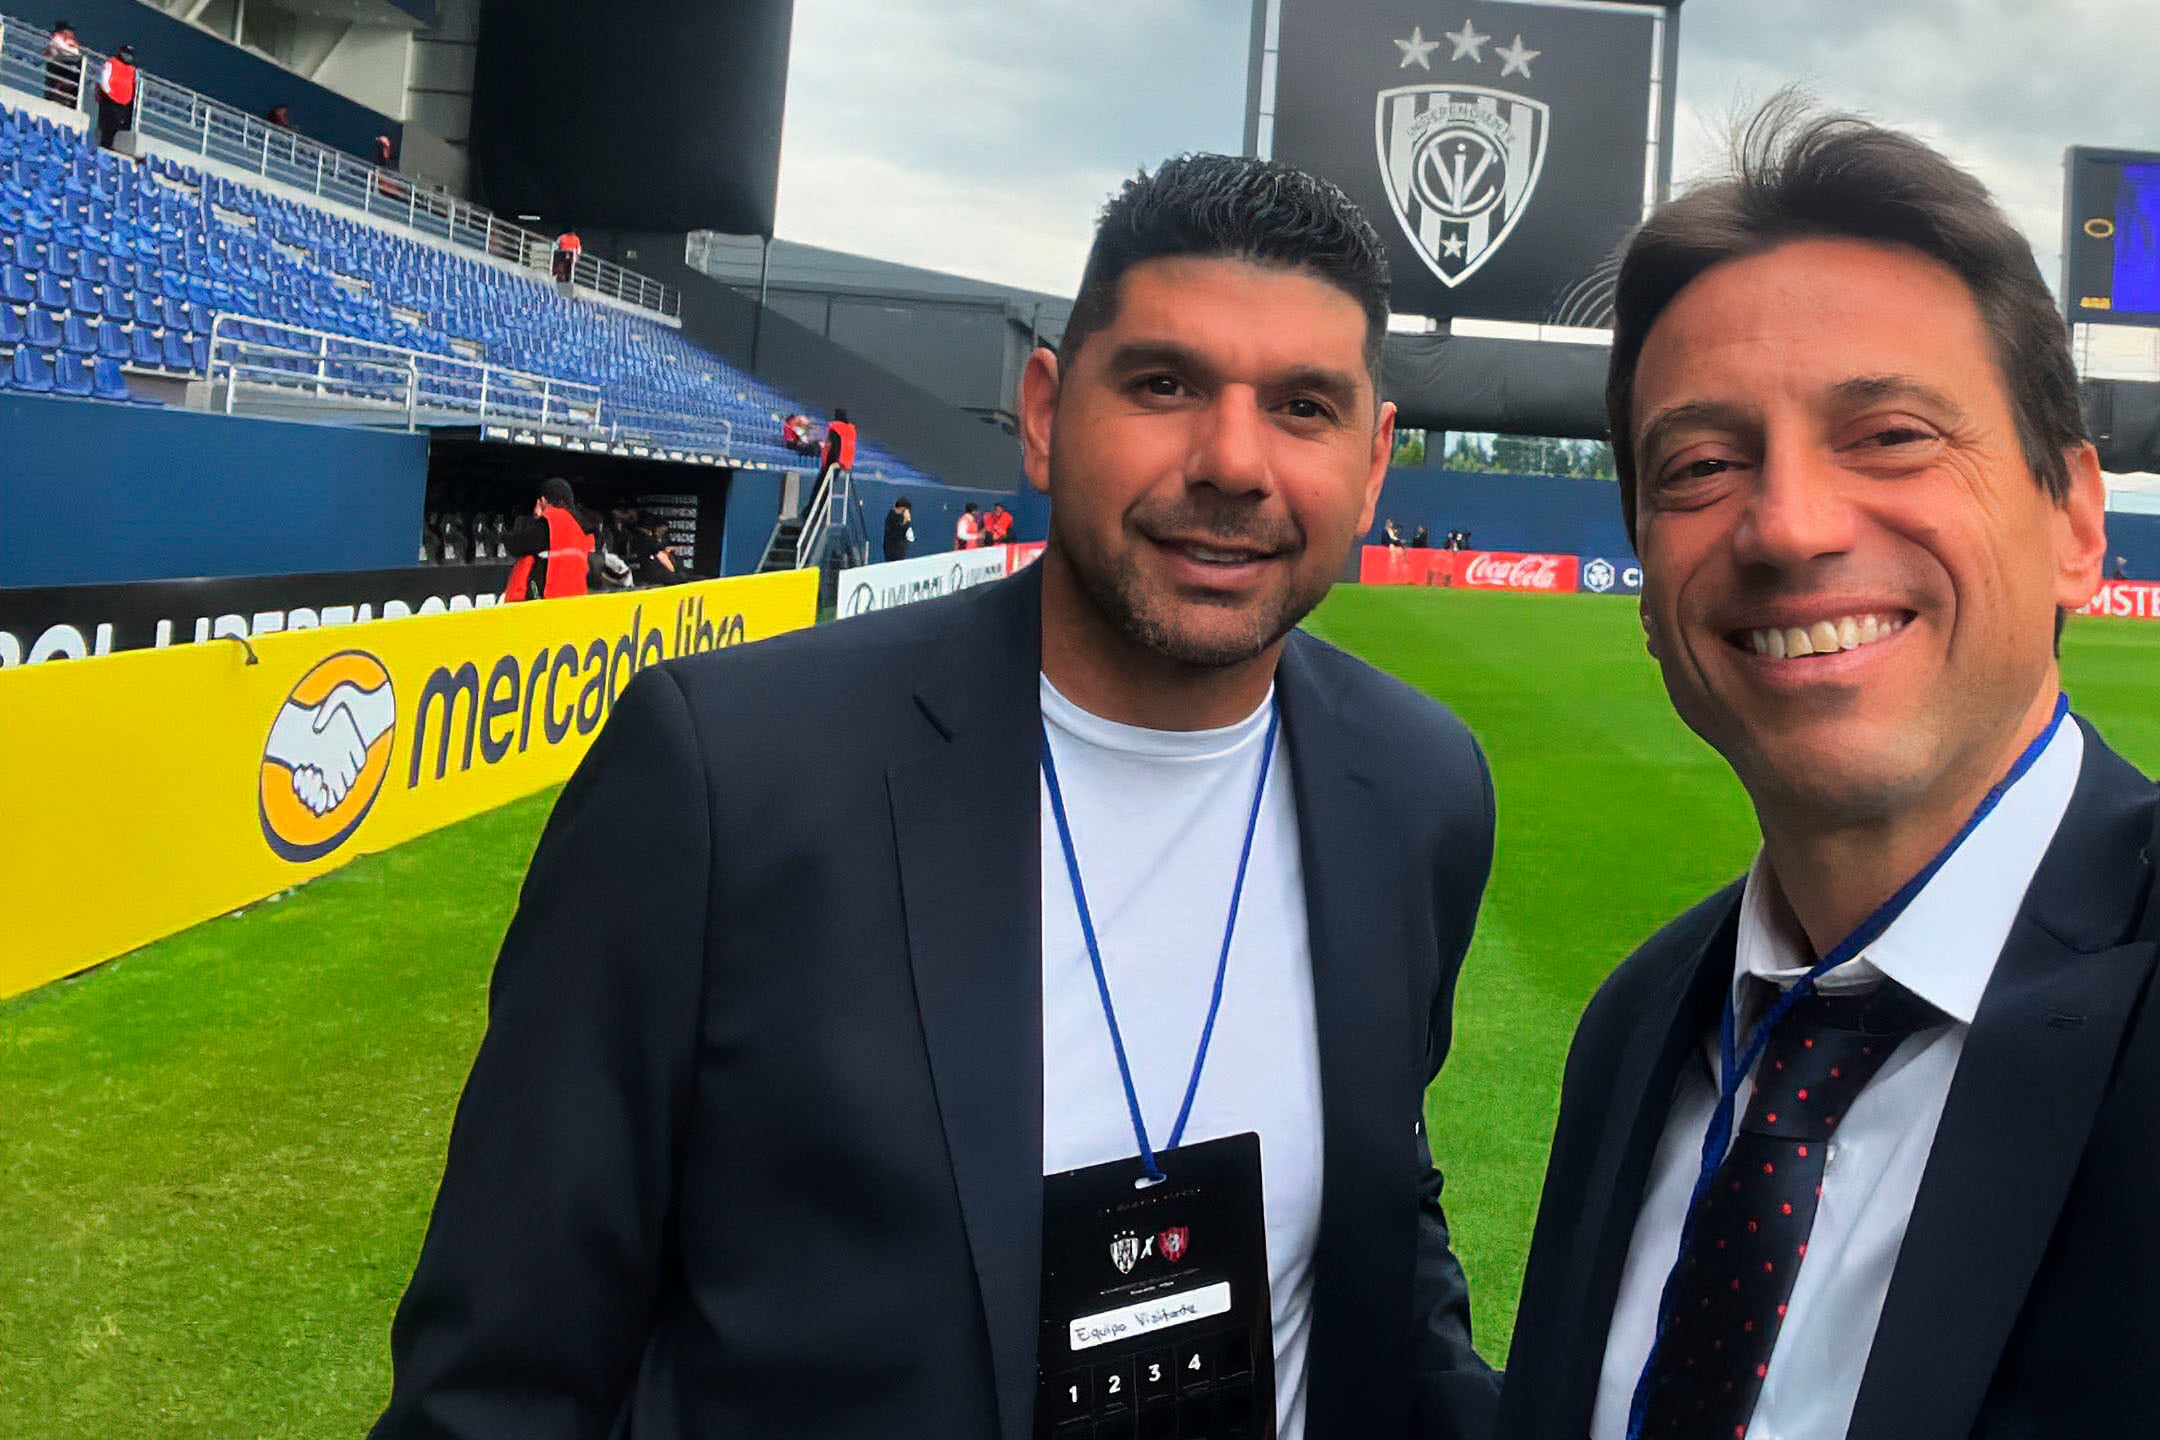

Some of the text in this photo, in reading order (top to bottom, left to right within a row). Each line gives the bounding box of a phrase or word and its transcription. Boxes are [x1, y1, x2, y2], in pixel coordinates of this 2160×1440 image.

[2075, 584, 2160, 617] MSTE
[1075, 1322, 1127, 1342] Equipo
[1068, 1353, 1201, 1403] 1 2 3 4
